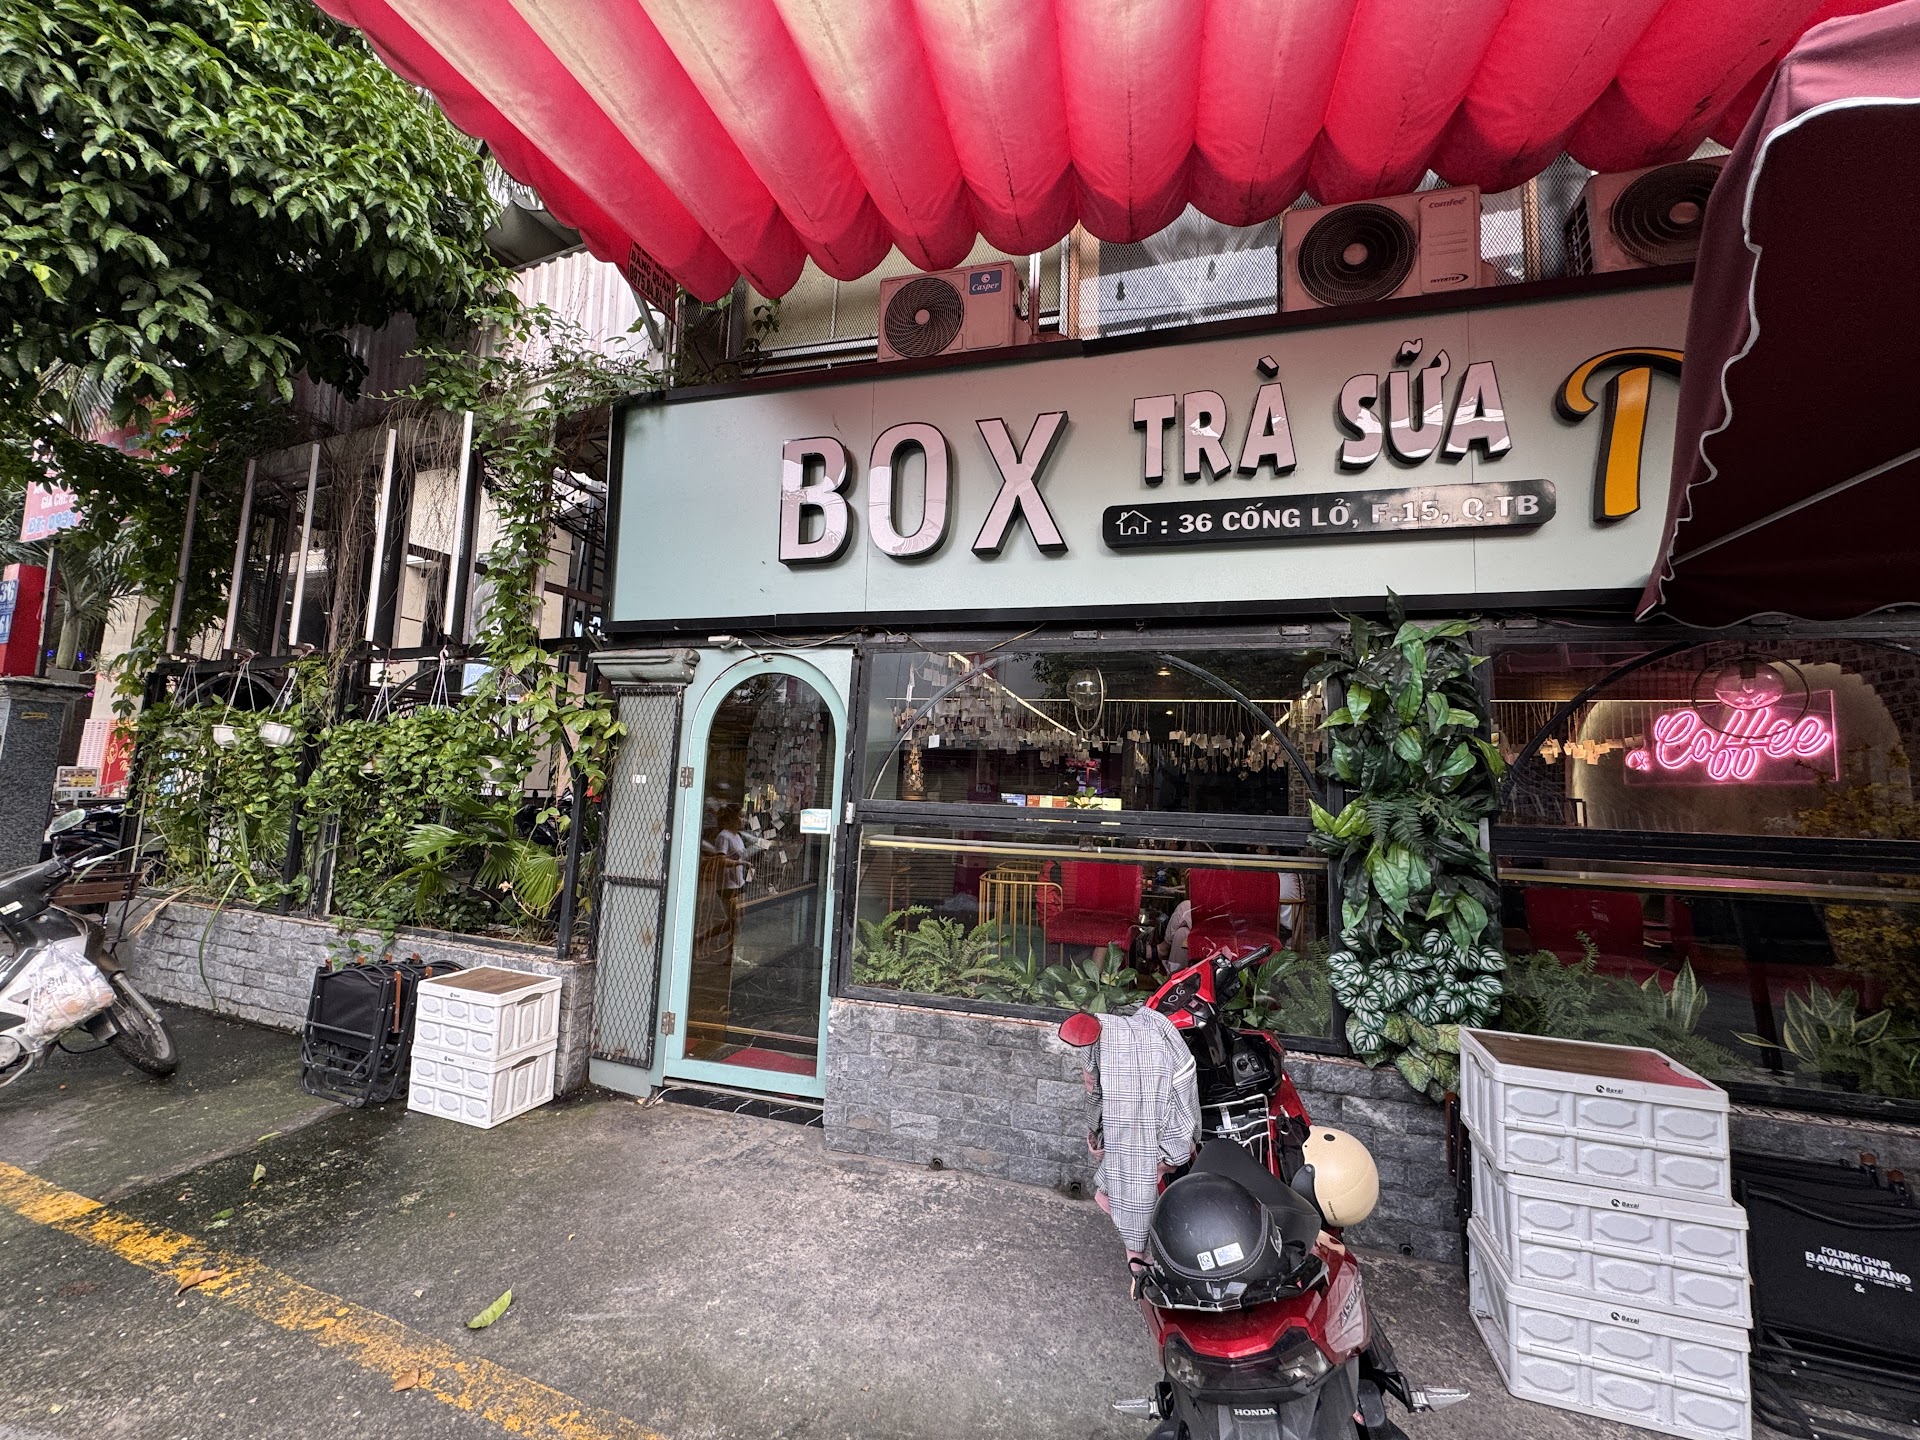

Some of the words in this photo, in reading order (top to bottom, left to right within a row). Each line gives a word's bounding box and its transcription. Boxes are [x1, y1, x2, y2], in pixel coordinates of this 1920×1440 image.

[972, 282, 999, 291] Casper
[1430, 275, 1460, 283] INVERTER
[778, 411, 1069, 566] BOX
[1132, 354, 1297, 484] TRÀ
[1337, 338, 1512, 471] SỮA
[1178, 512, 1213, 533] 36
[1222, 502, 1301, 531] CỐNG
[1461, 494, 1539, 522] Q.TB
[1654, 706, 1831, 781] Coffee
[1820, 1246, 1861, 1263] FOLDING
[1861, 1255, 1893, 1271] CHAIR
[1233, 1408, 1277, 1416] HONDA
